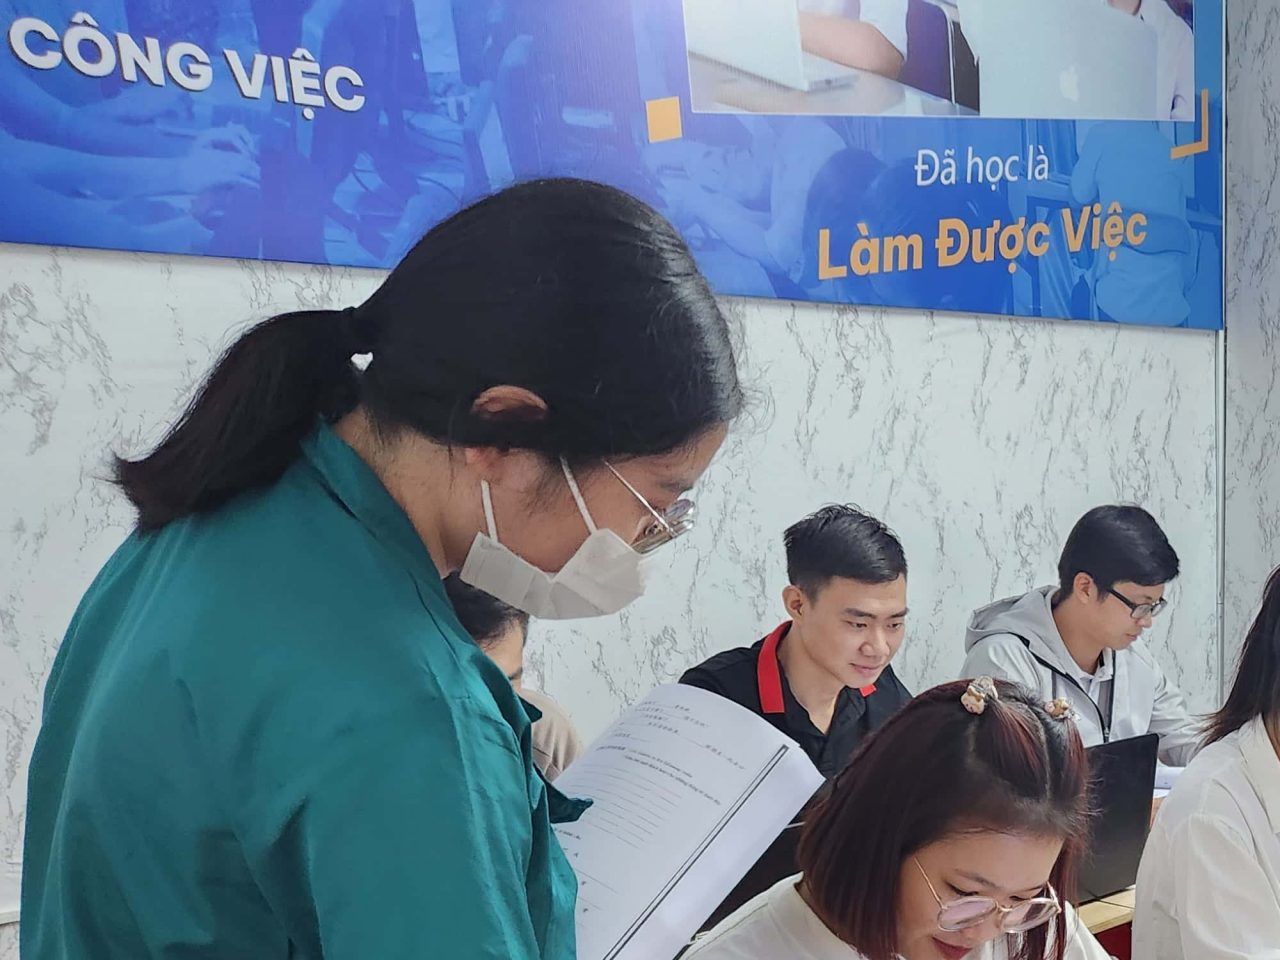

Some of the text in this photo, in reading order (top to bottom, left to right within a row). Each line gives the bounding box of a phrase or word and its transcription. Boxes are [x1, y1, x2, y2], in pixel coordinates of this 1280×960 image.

[9, 12, 366, 120] CÔNG VIỆC
[914, 144, 1050, 191] Đã học là
[818, 201, 1148, 280] Làm Được Việc
